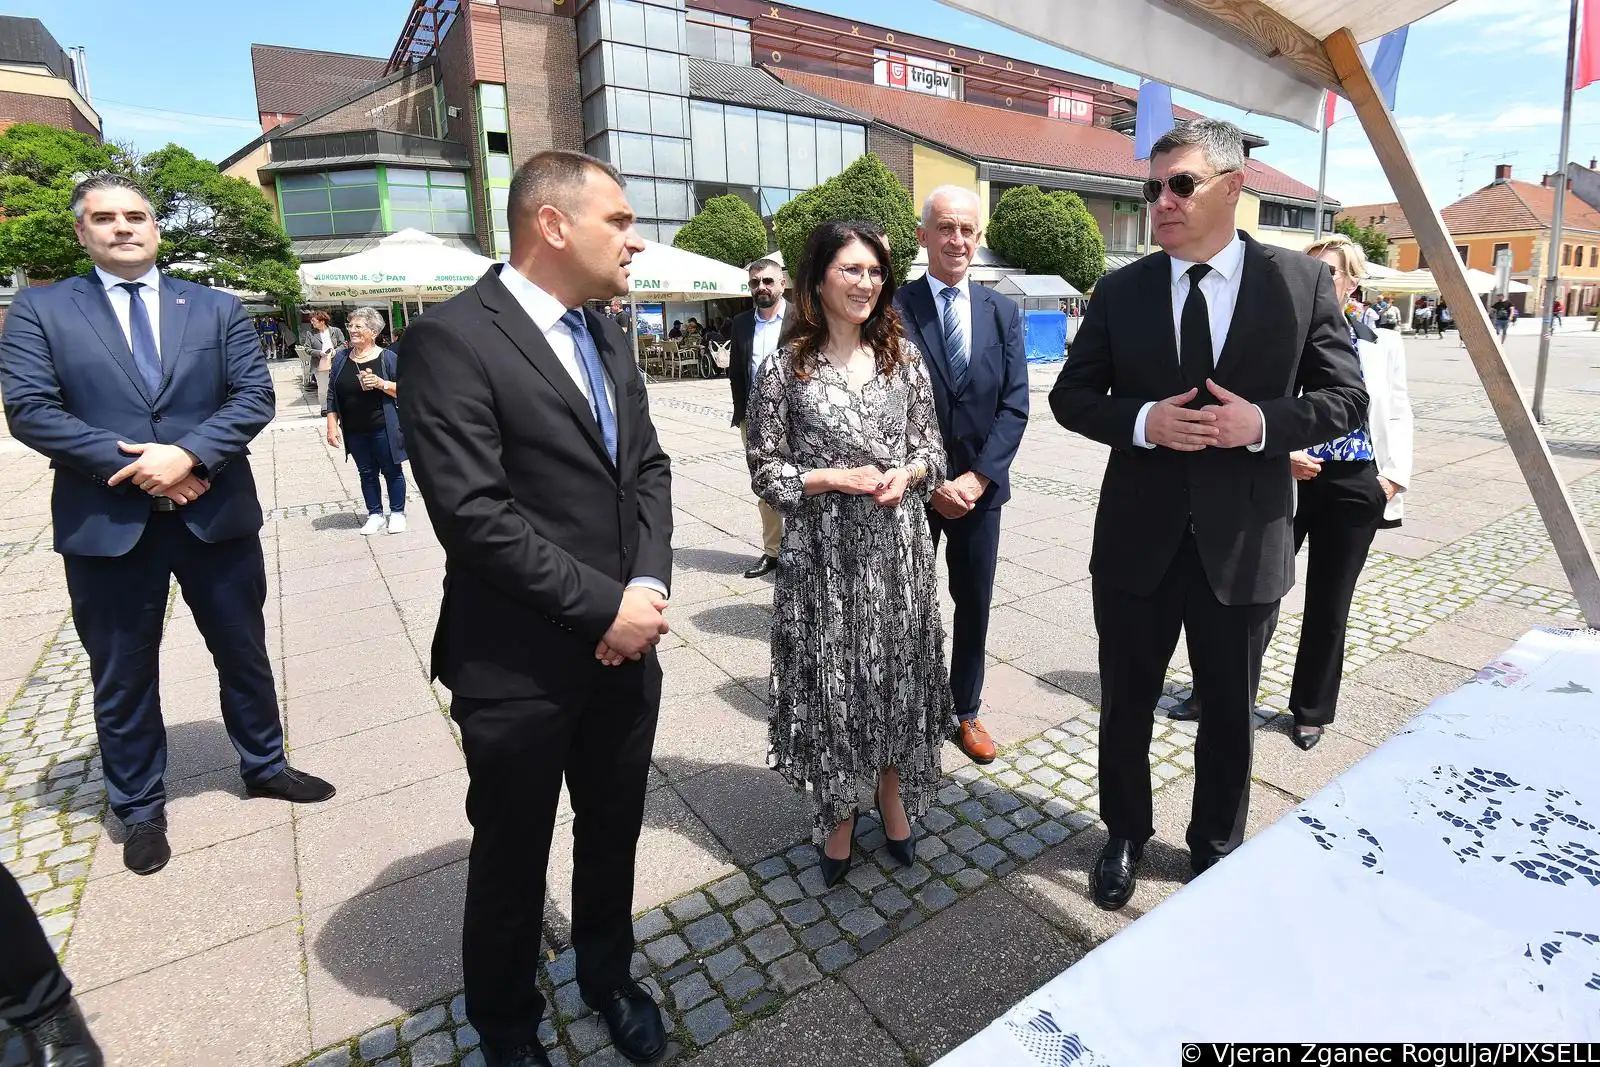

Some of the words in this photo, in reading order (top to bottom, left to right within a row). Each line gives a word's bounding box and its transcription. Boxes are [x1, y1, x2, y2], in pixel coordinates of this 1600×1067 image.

[911, 67, 950, 89] triglav
[634, 279, 661, 289] PAN
[693, 281, 717, 290] PAN
